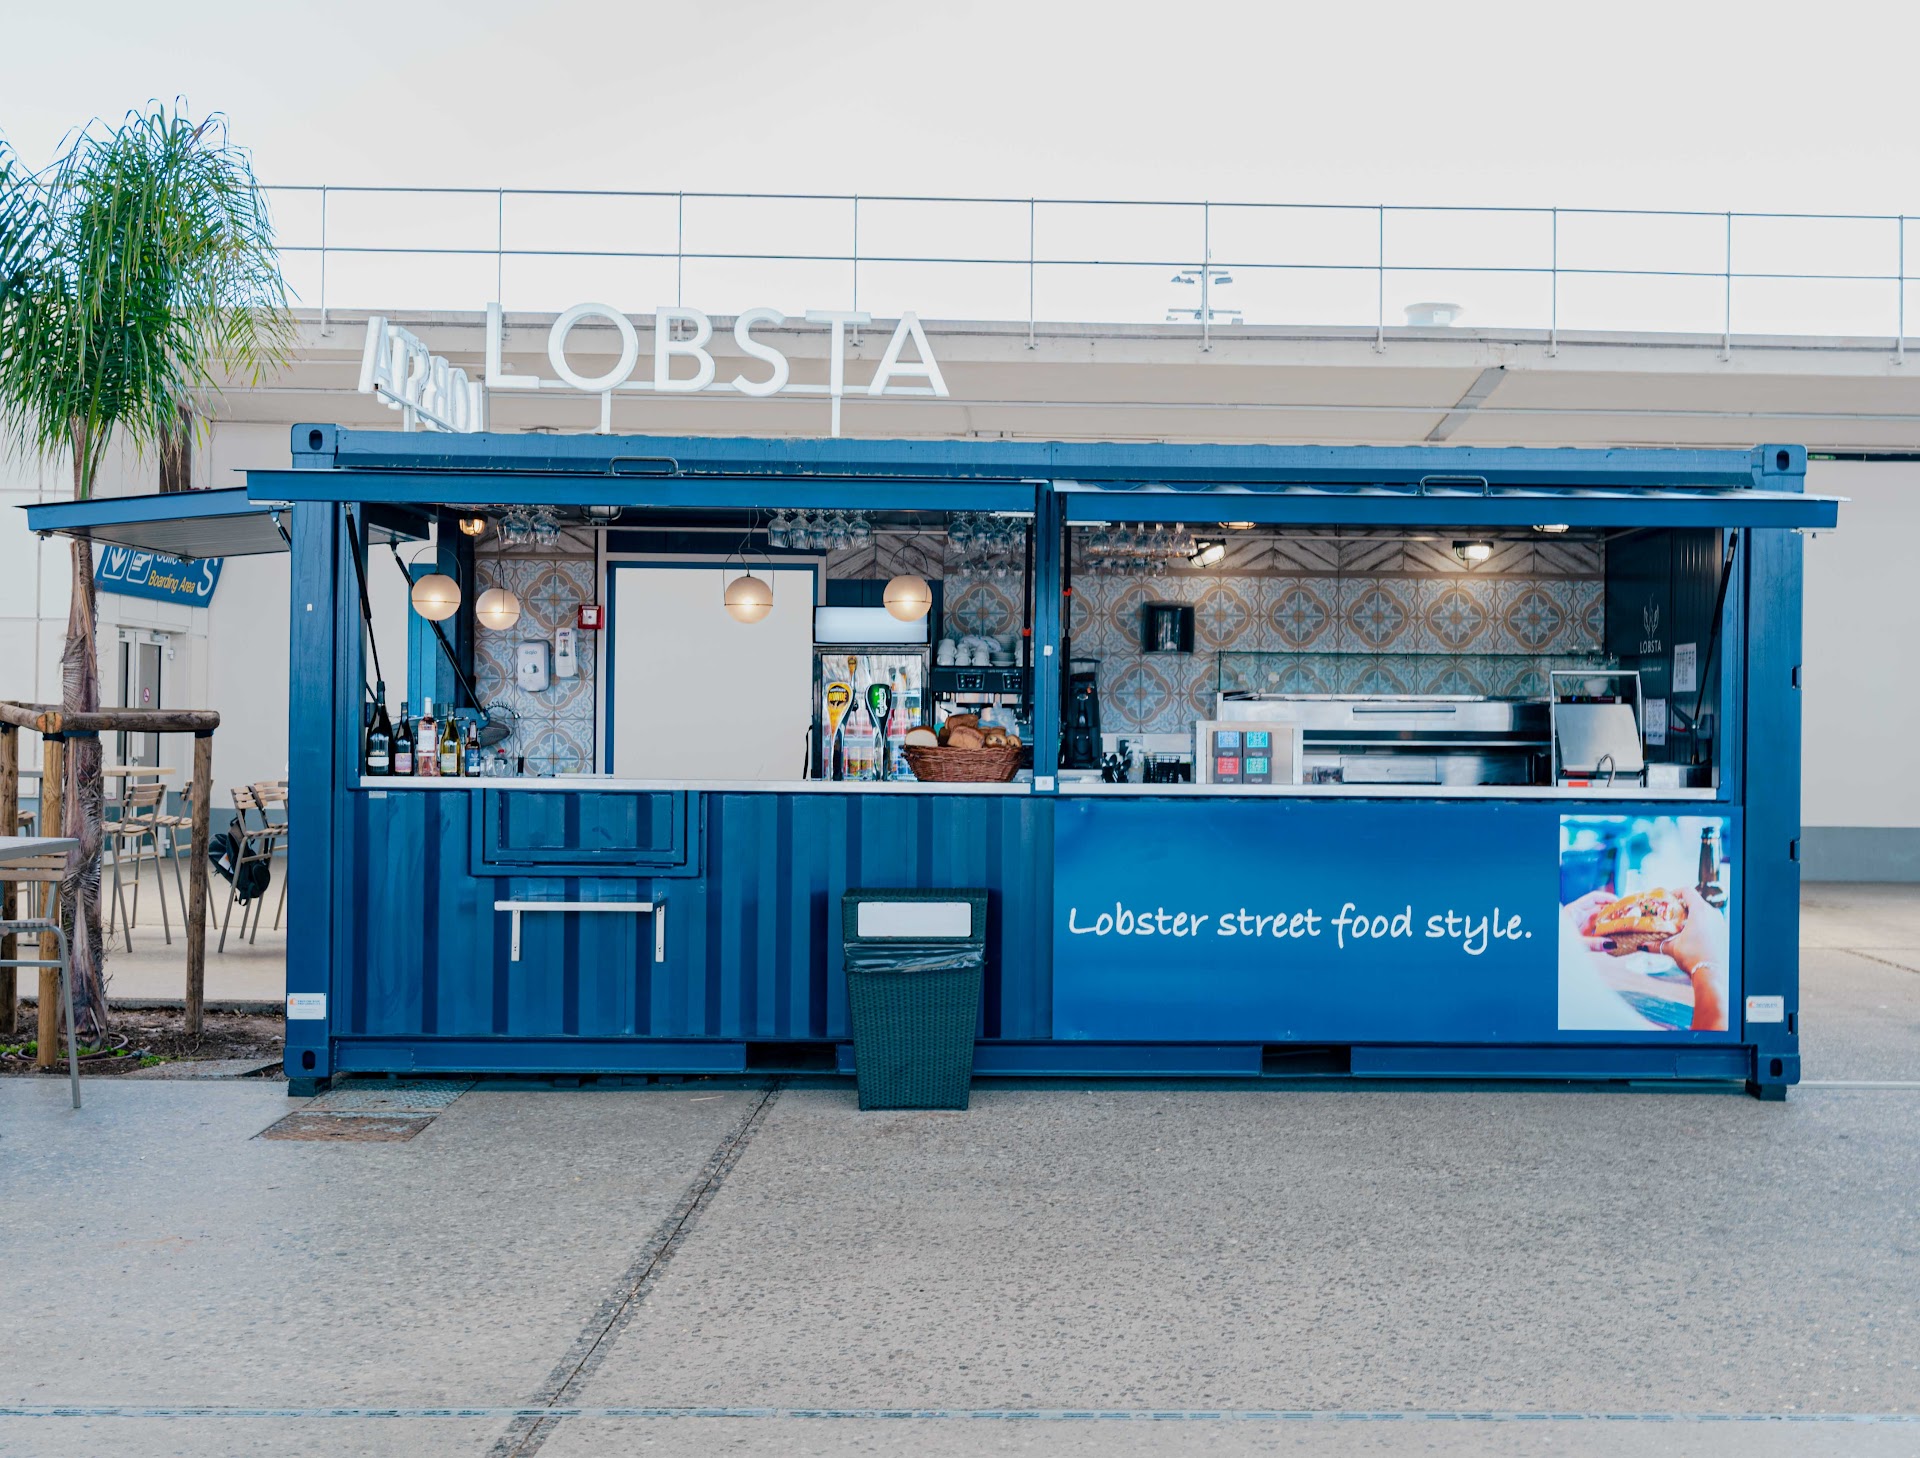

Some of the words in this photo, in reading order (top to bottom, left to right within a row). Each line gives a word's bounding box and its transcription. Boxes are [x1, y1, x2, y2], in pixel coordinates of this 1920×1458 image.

[485, 302, 950, 397] LOBSTA
[148, 570, 179, 594] Boarding
[179, 576, 196, 593] Area
[1640, 640, 1662, 654] LOBSTA
[1068, 902, 1209, 936] Lobster
[1217, 907, 1322, 938] street
[1331, 902, 1412, 948] food
[1425, 905, 1532, 956] style.
